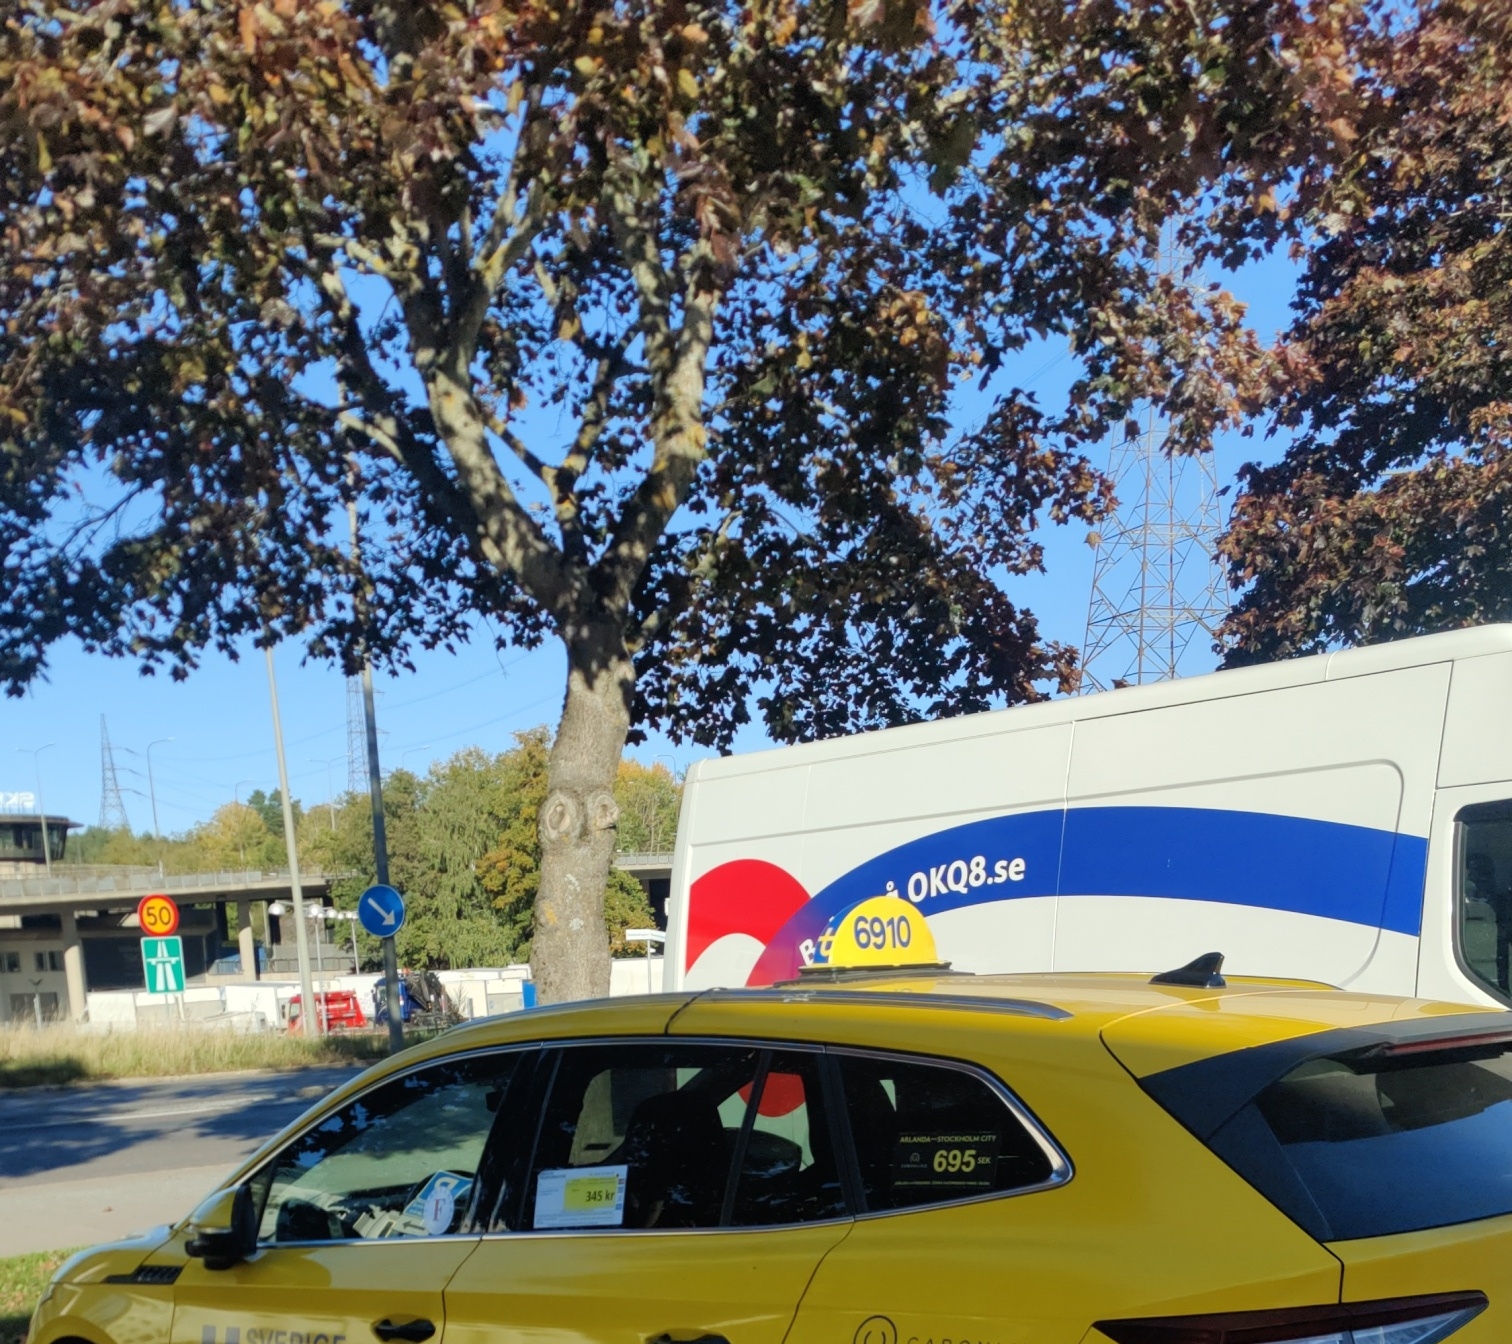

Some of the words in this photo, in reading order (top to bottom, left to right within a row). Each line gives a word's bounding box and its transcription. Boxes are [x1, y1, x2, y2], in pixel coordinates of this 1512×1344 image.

[907, 855, 1026, 903] OKQ8.se
[146, 906, 171, 926] 50
[854, 915, 911, 950] 6910
[933, 1149, 977, 1173] 695
[977, 1156, 992, 1165] SEK
[586, 1190, 603, 1202] 345
[605, 1189, 615, 1201] kr
